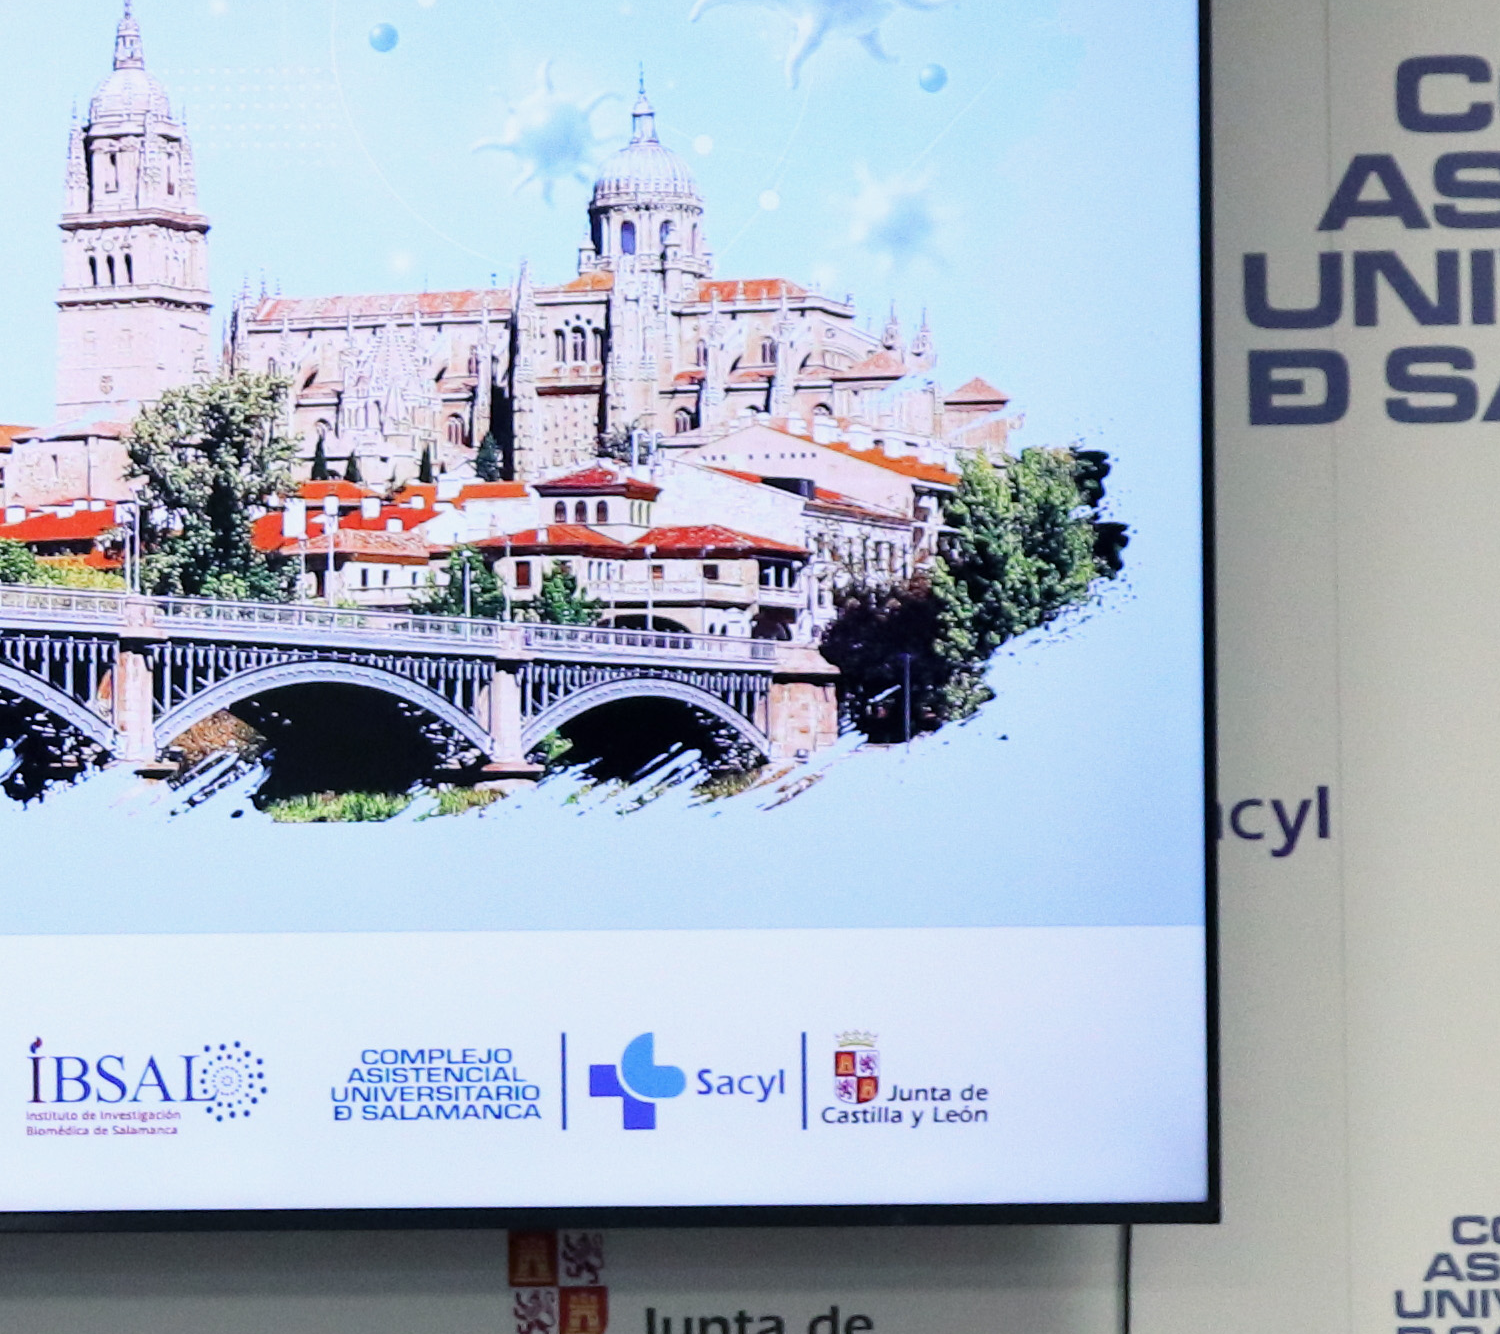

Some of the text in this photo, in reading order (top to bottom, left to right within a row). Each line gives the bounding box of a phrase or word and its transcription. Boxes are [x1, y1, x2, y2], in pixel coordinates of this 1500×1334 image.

[361, 1049, 512, 1065] COMPLEJO
[348, 1067, 524, 1083] ASISTENCIAL
[332, 1085, 540, 1102] UNIVERSITARIO
[697, 1069, 784, 1103] Sacyl
[887, 1085, 988, 1101] Junta de
[82, 1111, 96, 1120] de
[362, 1104, 541, 1120] SALAMANCA
[822, 1106, 988, 1128] Castilla y León
[27, 1125, 178, 1136] Biomédica de Salamanca
